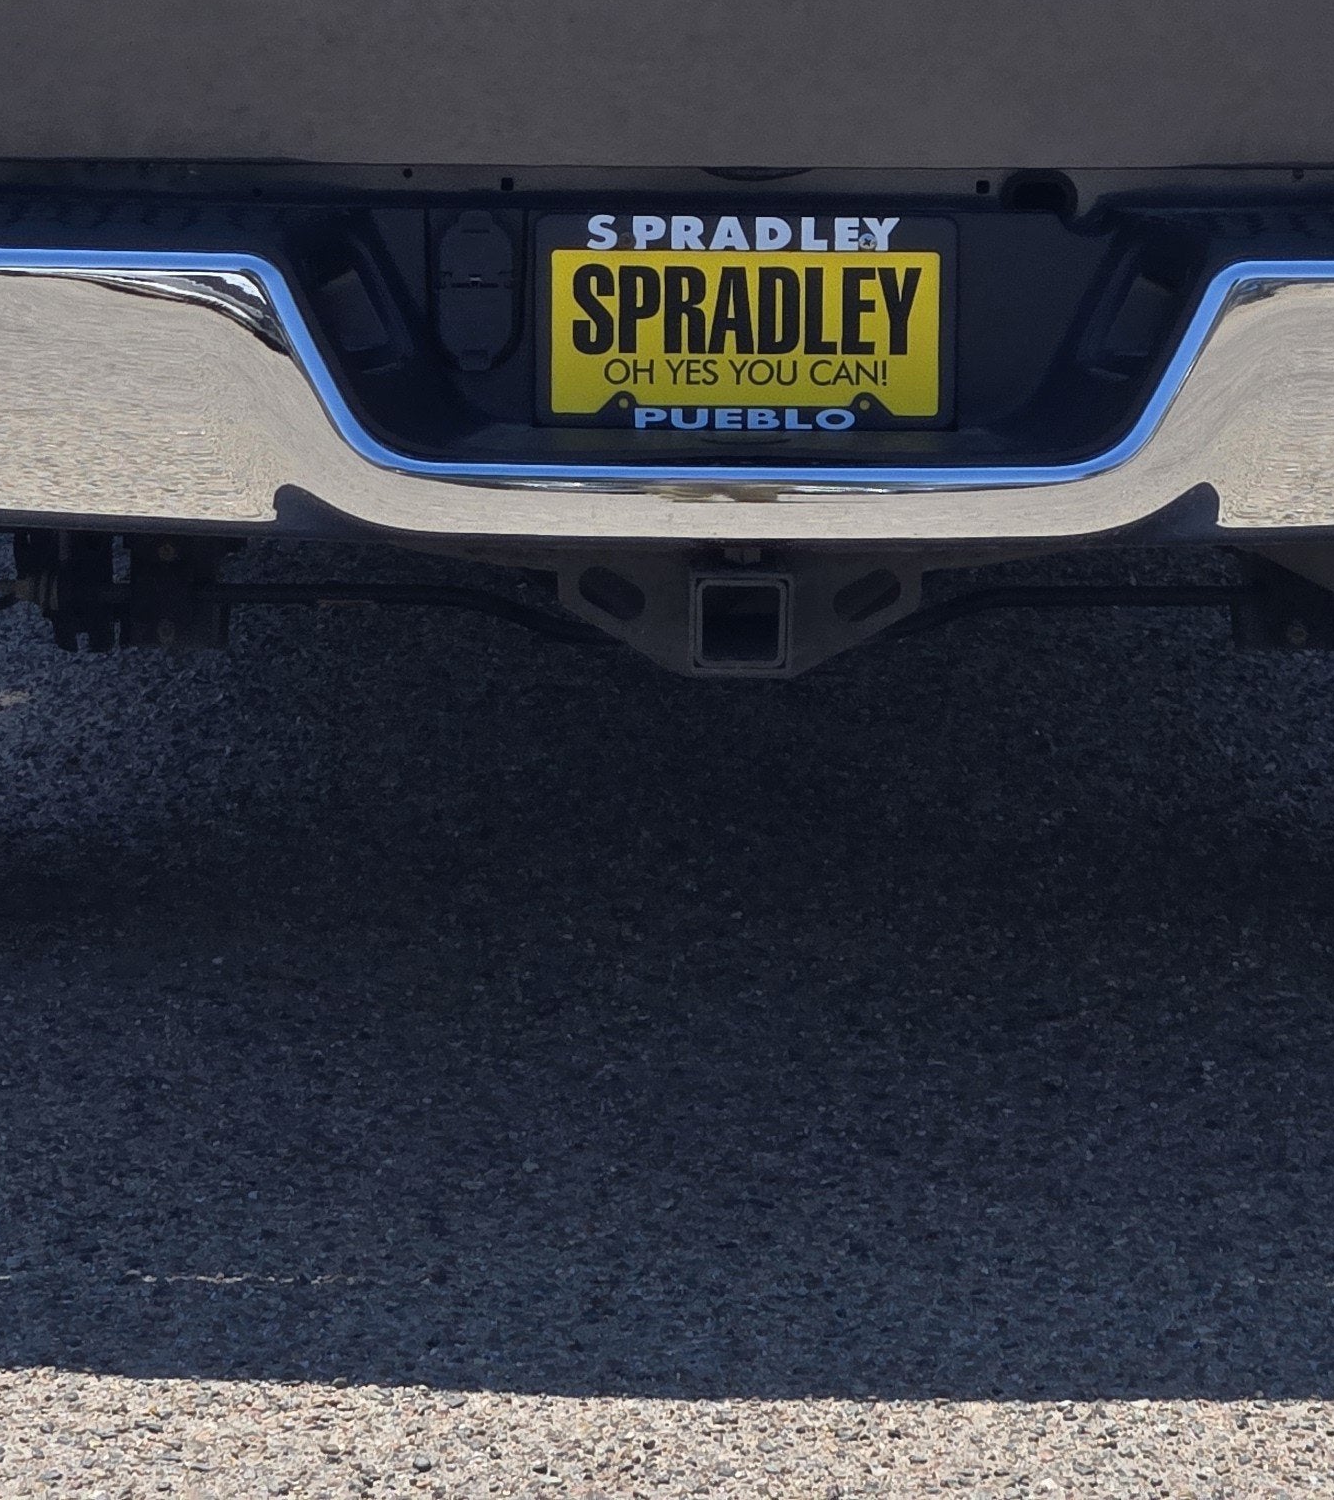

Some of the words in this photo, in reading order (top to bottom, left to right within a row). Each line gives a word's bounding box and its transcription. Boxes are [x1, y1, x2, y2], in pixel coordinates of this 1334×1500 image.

[571, 263, 922, 356] SPRADLEY
[603, 358, 655, 385] OH
[665, 358, 719, 386] YES
[728, 359, 798, 386] YOU
[809, 359, 889, 387] CAN!
[633, 407, 856, 431] PUEBLO
